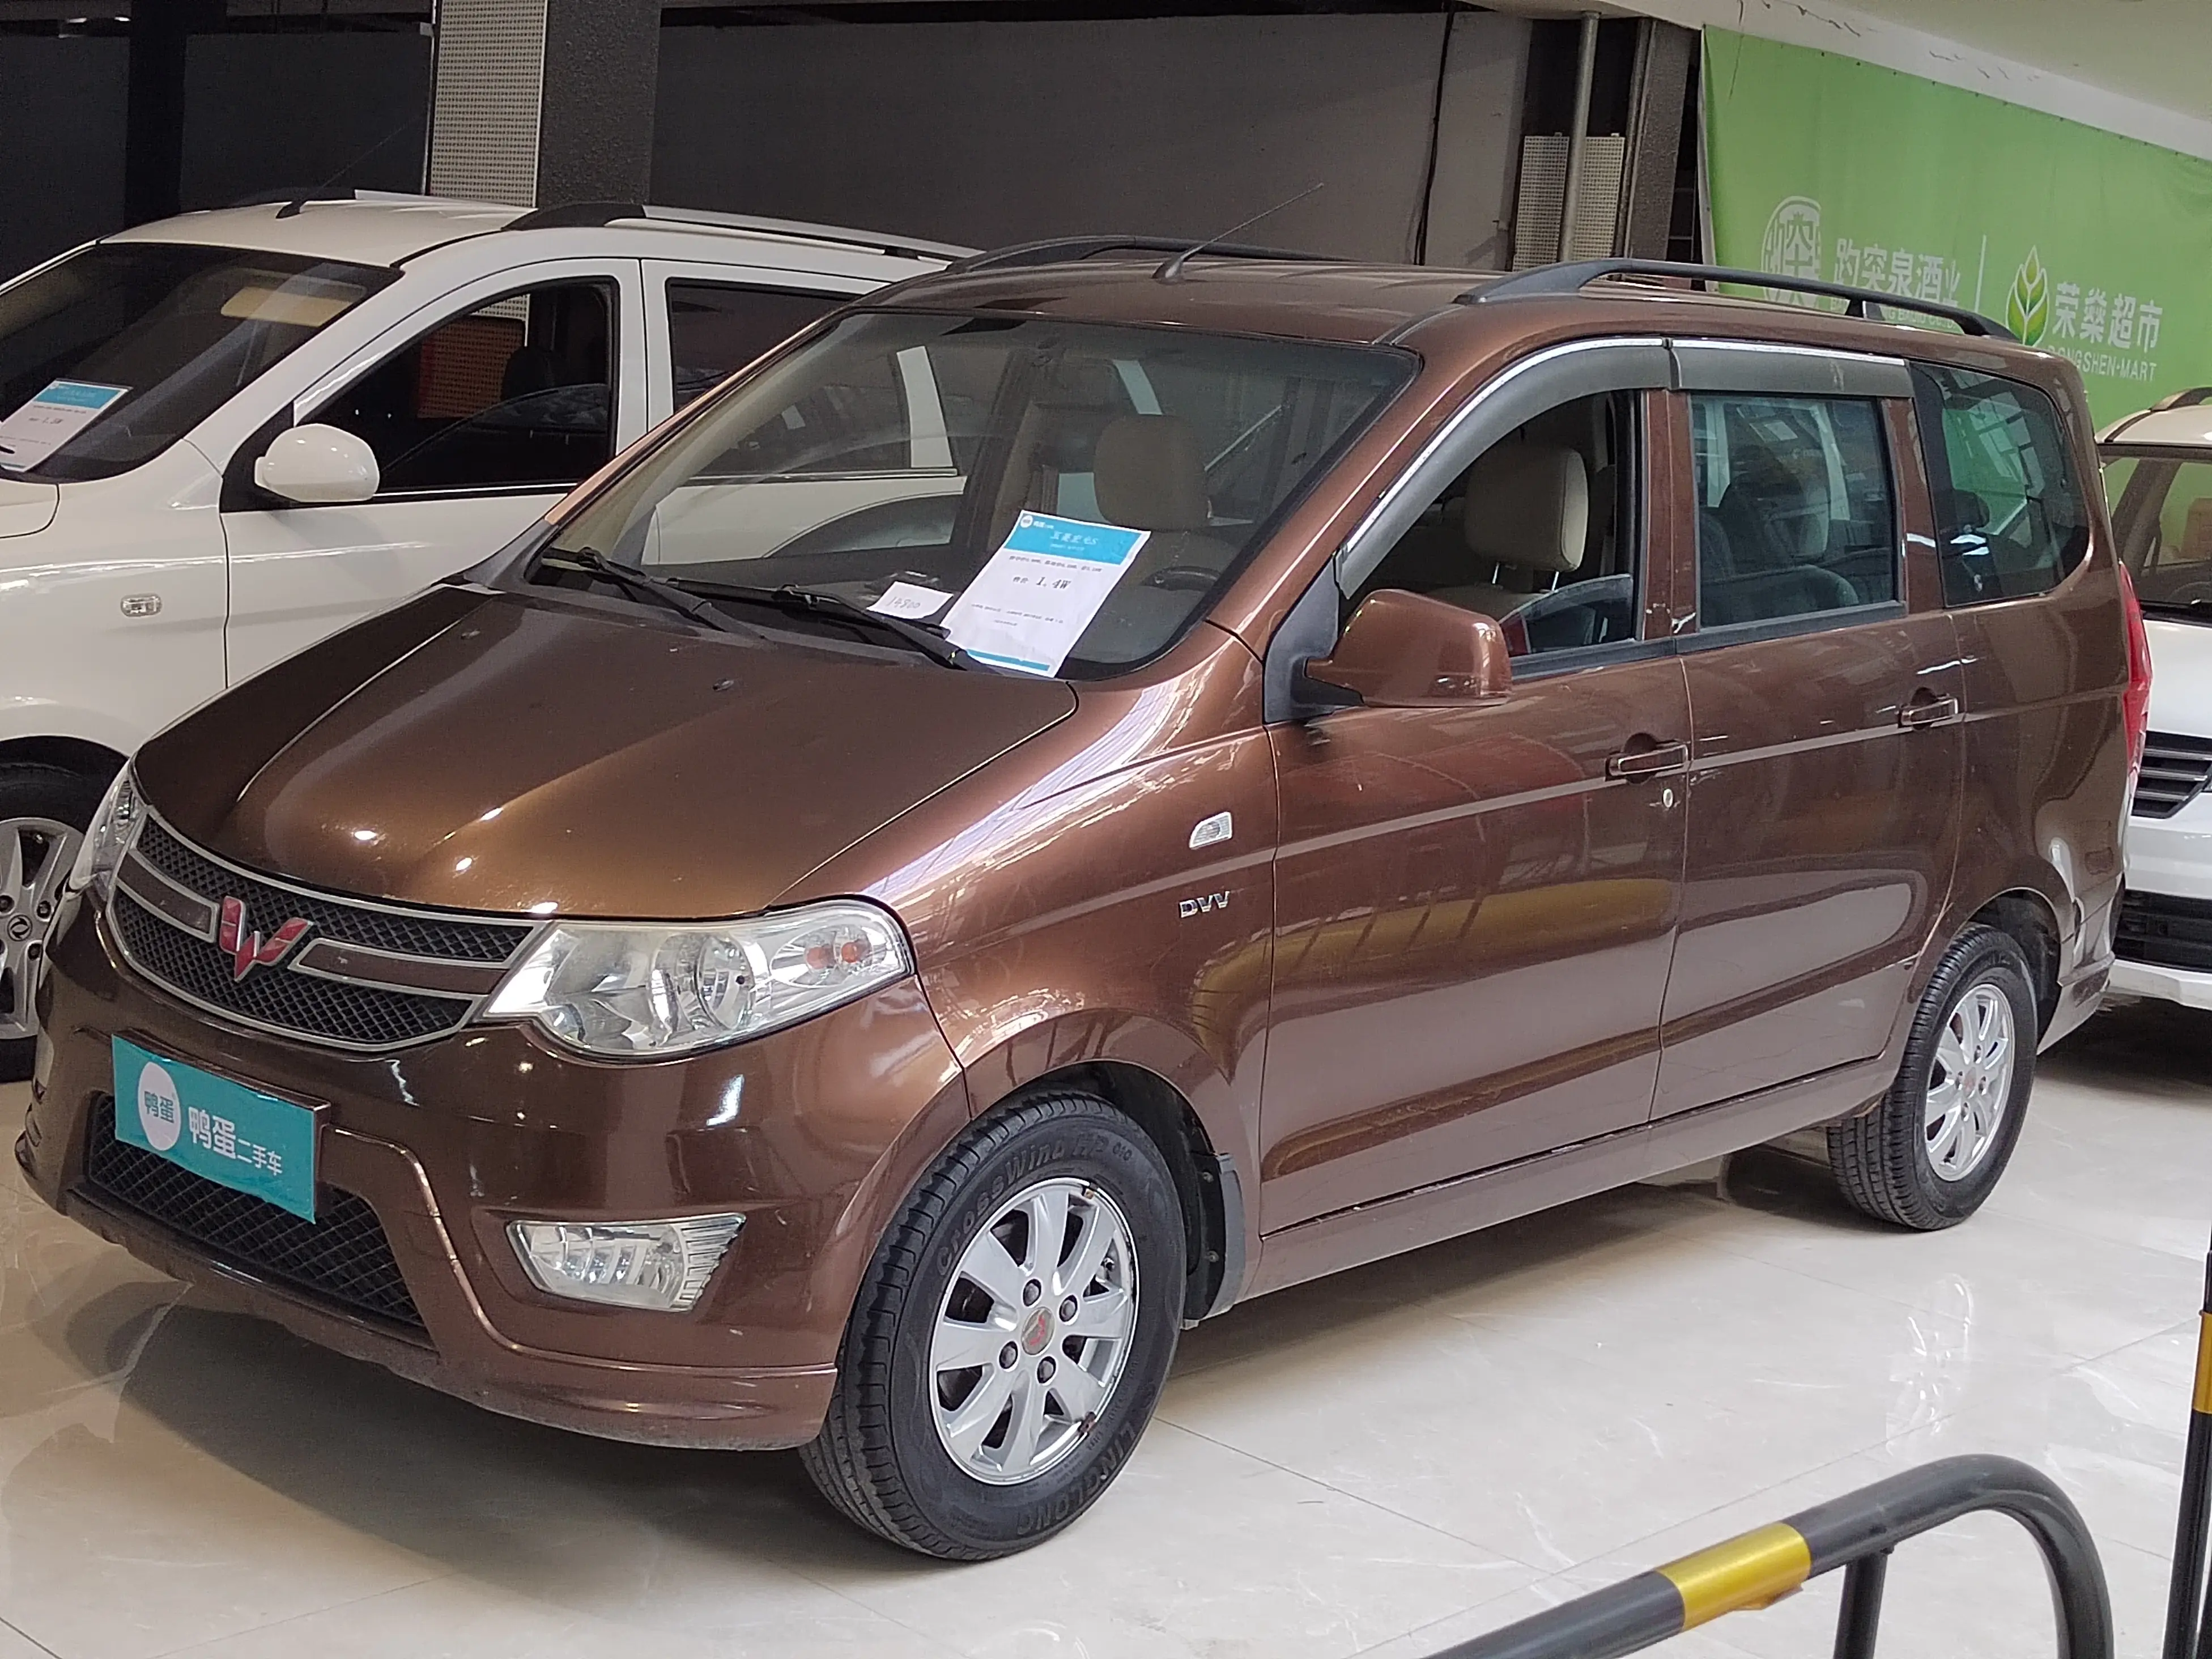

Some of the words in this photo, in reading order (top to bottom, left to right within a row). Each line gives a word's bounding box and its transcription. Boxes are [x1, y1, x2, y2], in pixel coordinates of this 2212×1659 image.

[2052, 282, 2163, 354] 荣燊超市
[1179, 891, 1230, 918] DVV
[144, 1090, 175, 1124] 鸭蛋
[188, 1105, 283, 1176] 鸭蛋二手车
